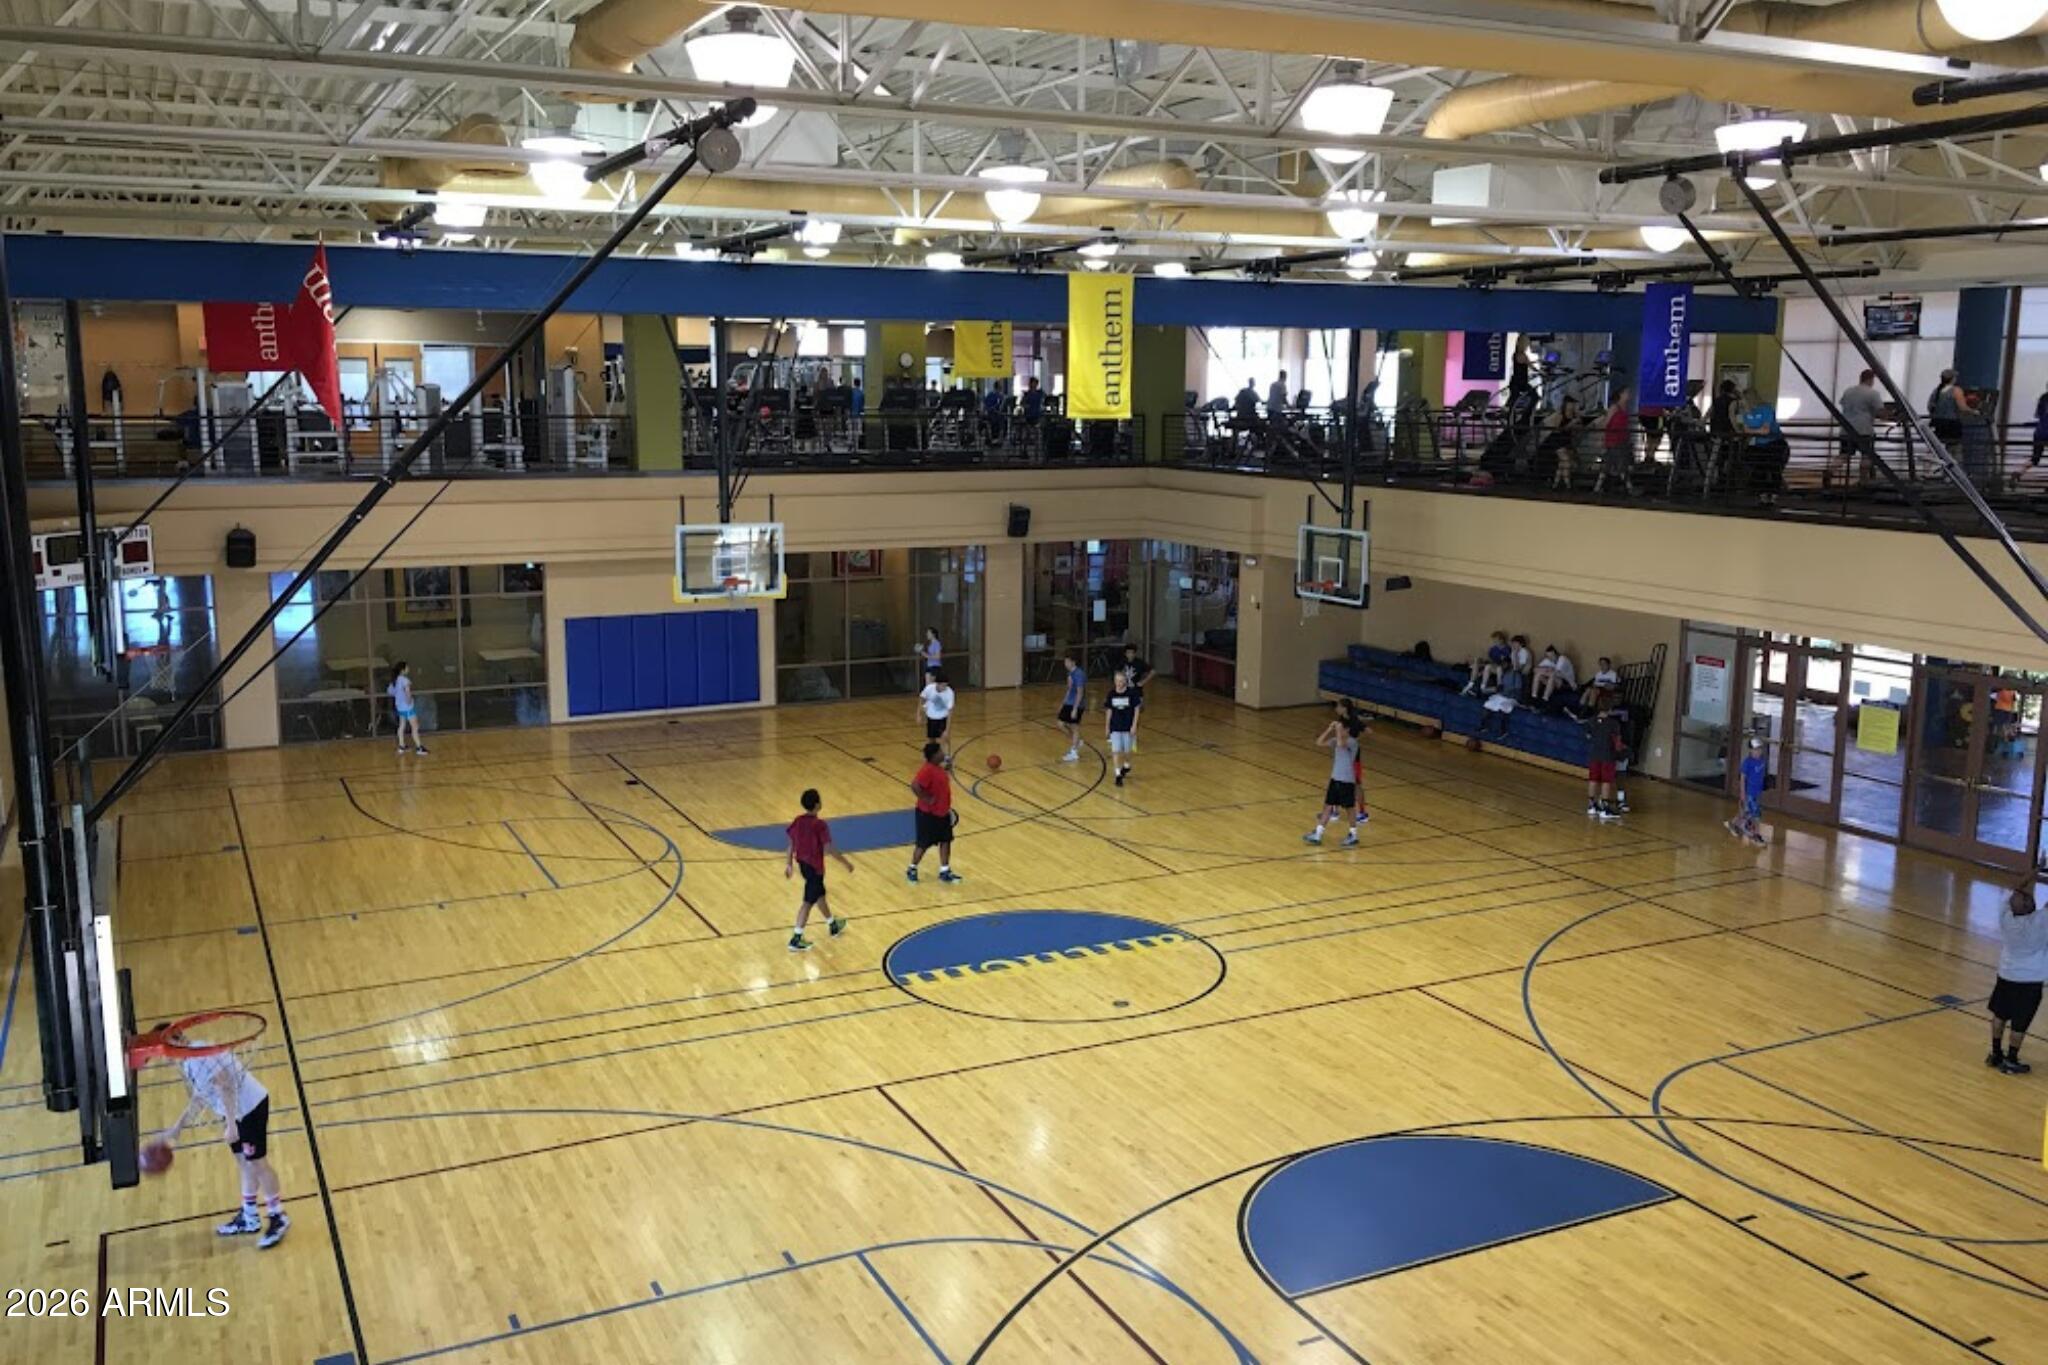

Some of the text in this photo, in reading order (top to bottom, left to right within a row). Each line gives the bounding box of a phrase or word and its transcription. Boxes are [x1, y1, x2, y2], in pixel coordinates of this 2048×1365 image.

[987, 320, 1003, 369] anth
[1098, 288, 1122, 407] anthem
[1664, 294, 1686, 397] anthem
